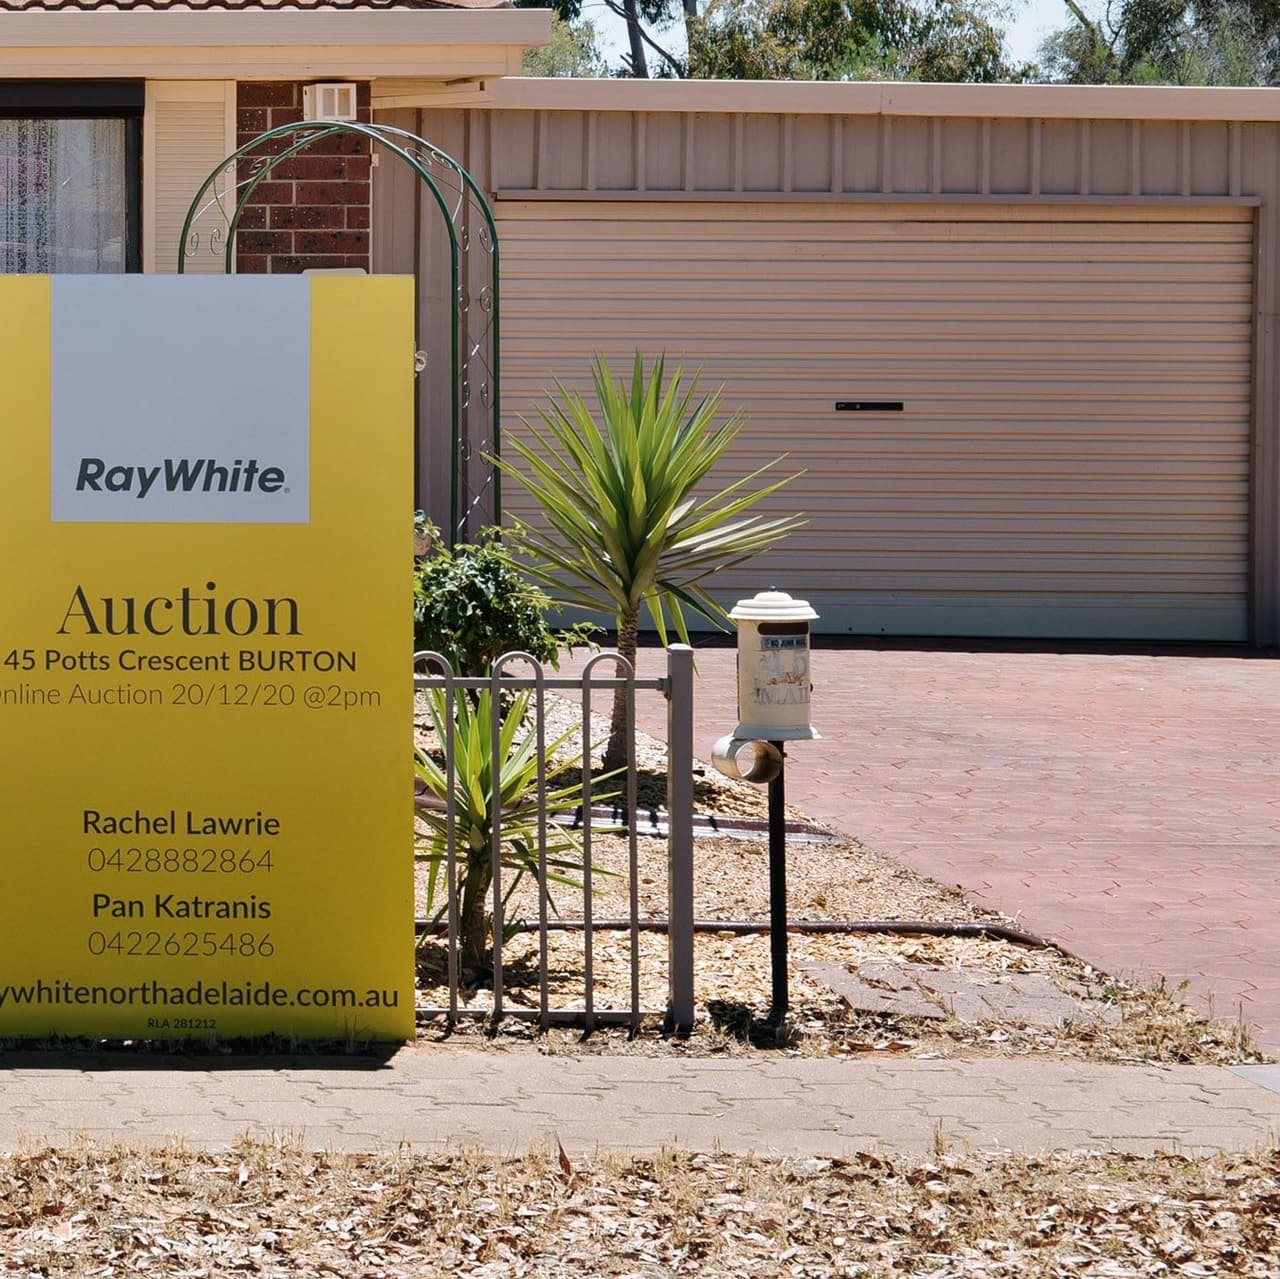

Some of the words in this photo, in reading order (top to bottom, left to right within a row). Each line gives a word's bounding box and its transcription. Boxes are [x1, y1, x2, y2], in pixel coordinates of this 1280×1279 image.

[56, 581, 303, 637] Auction
[3, 649, 36, 671] 45
[45, 649, 111, 671] Potts
[118, 649, 231, 672] Crescent
[238, 650, 357, 673] BURTON
[68, 681, 164, 706] Auction
[171, 681, 296, 708] 20/12/20
[303, 682, 382, 712] @2pm
[82, 809, 176, 835] Rachel
[186, 810, 281, 836] Lawrie
[87, 847, 274, 874] 0428882864
[93, 893, 145, 919] Pan
[155, 893, 272, 920] Katranis
[87, 930, 275, 958] 0422625486
[147, 1018, 170, 1029] RLA
